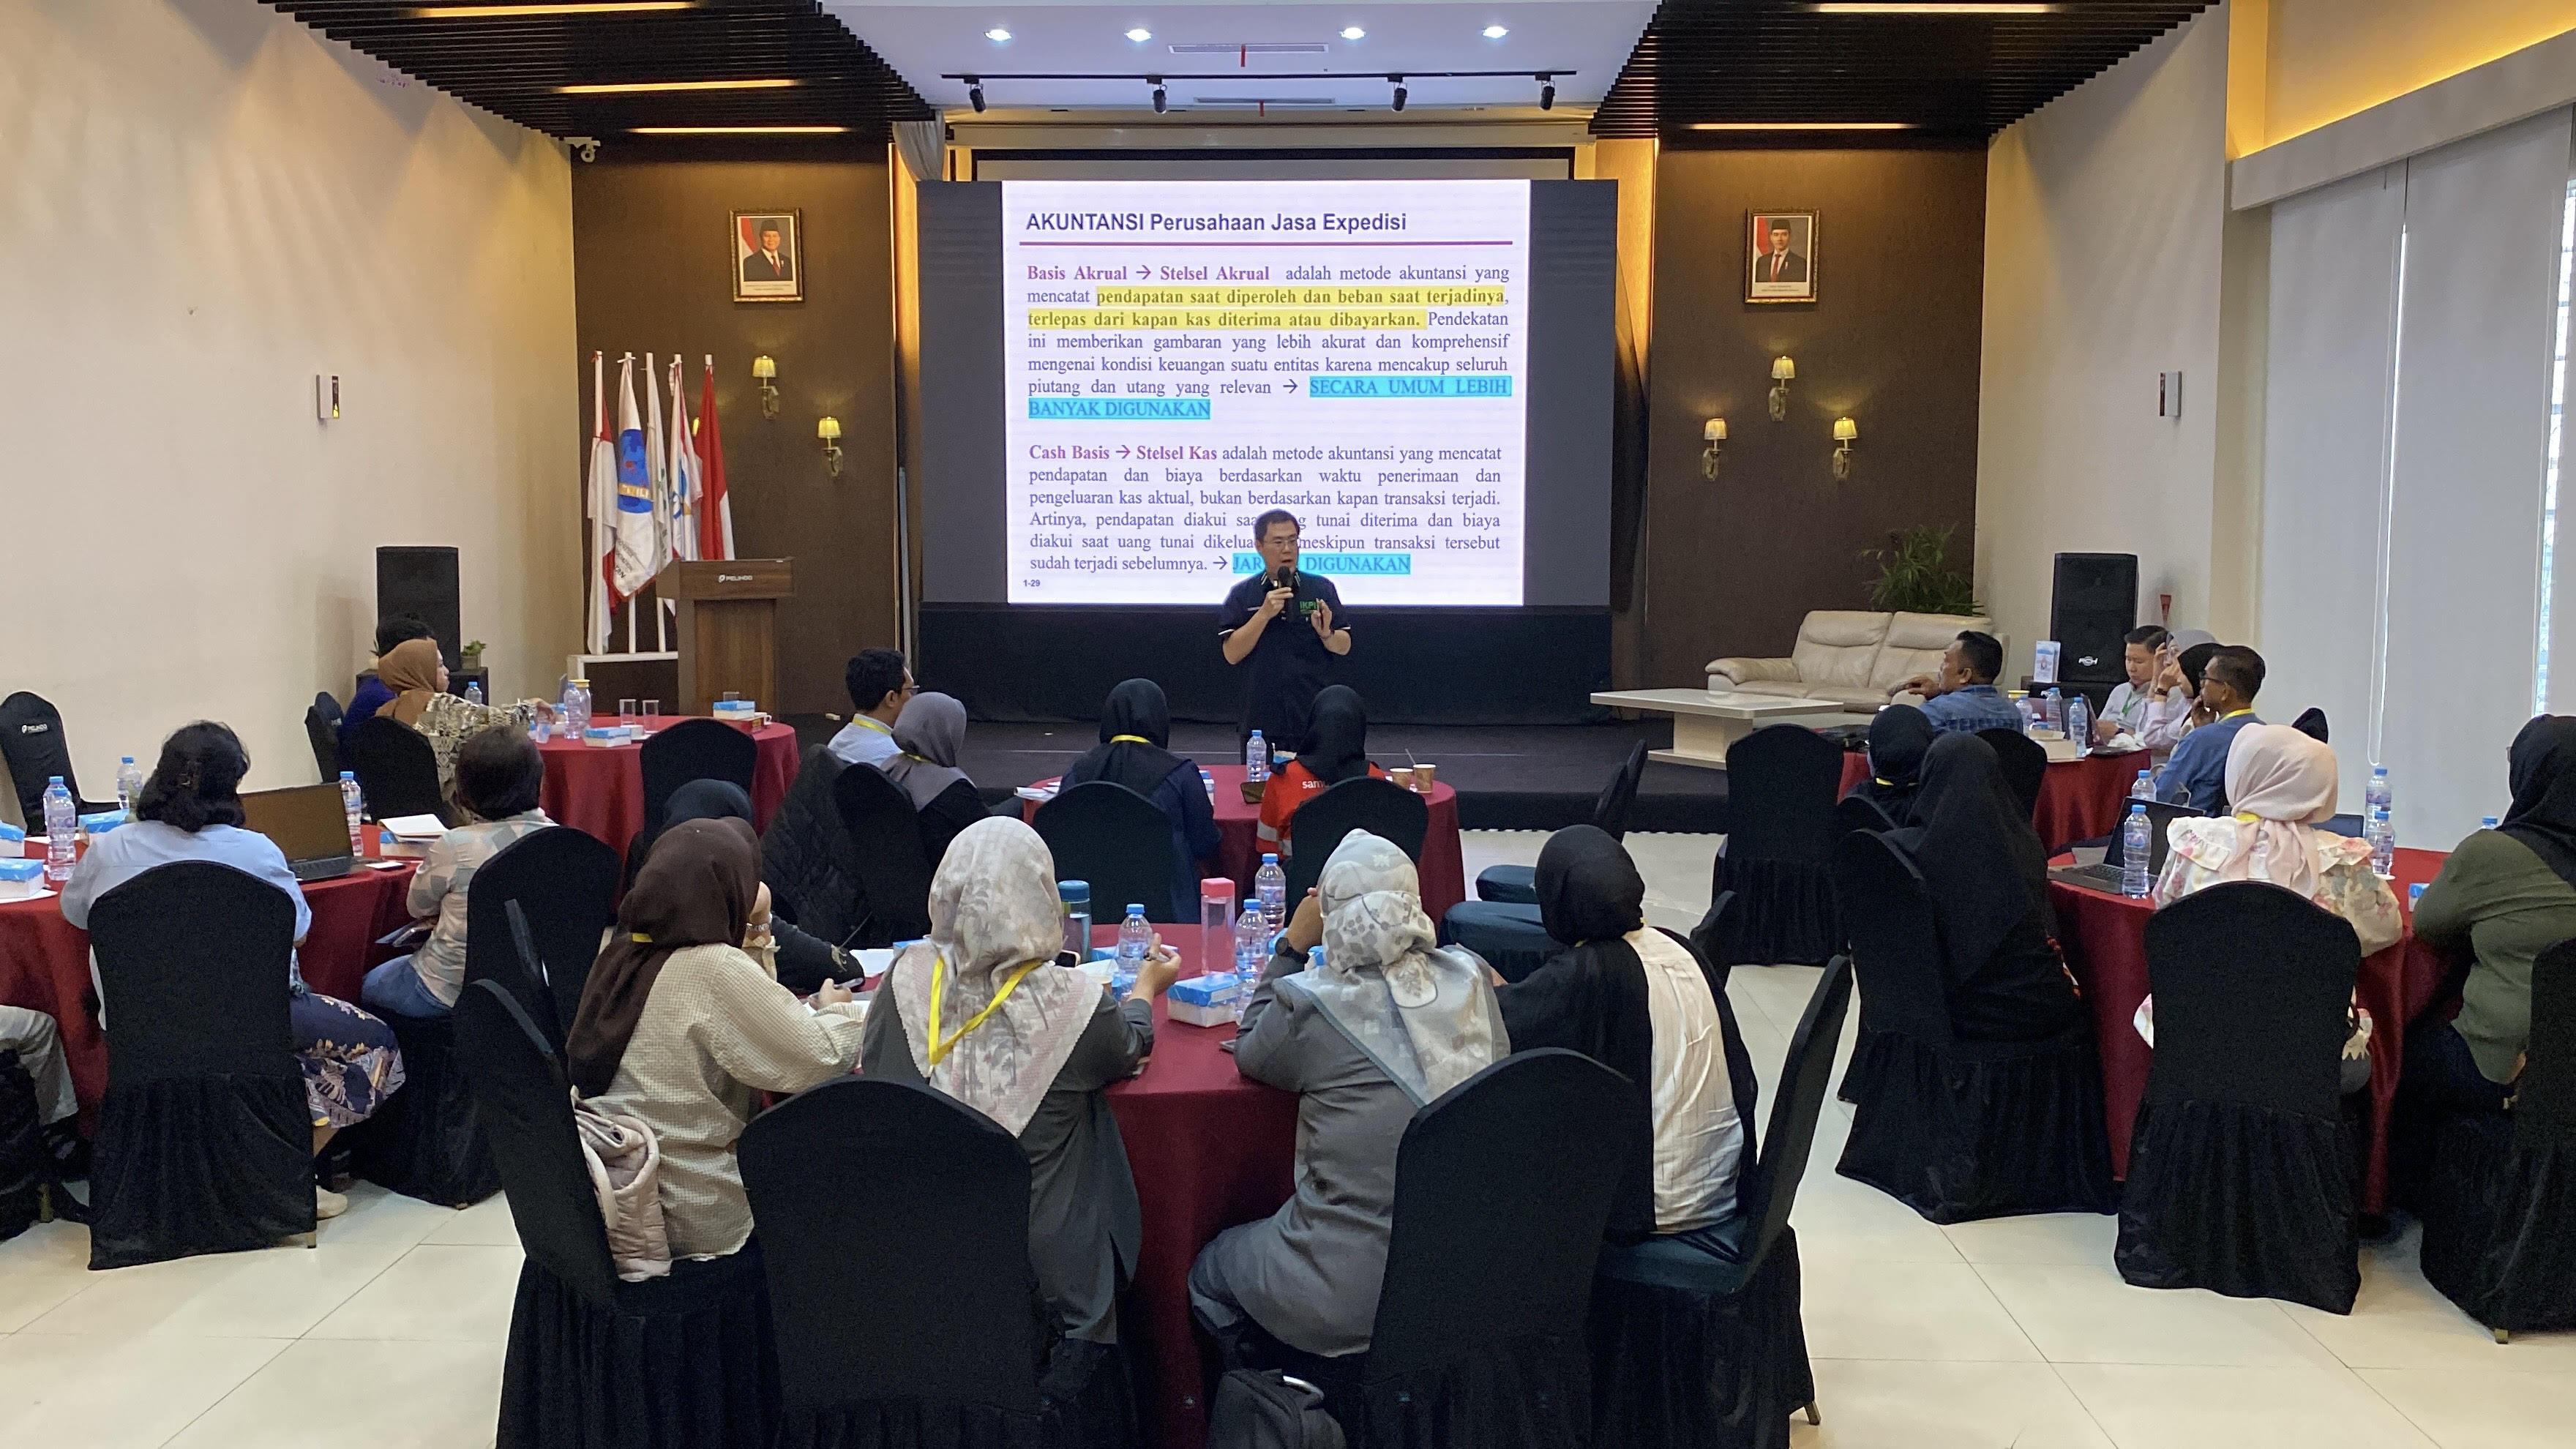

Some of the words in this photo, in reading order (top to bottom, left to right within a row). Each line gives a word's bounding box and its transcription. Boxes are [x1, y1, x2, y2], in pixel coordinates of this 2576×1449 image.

[1026, 213, 1144, 231] AKUNTANSI
[1150, 213, 1265, 231] Perusahaan
[1271, 213, 1317, 231] Jasa
[1323, 213, 1406, 234] Expedisi
[1027, 266, 1066, 280] Basis
[1074, 266, 1127, 280] Akrual
[1161, 266, 1208, 280] Stelsel
[1216, 266, 1270, 280] Akrual
[1286, 266, 1332, 280] adalah
[1339, 265, 1391, 280] metode
[1399, 265, 1467, 280] akuntansi
[1475, 269, 1509, 282] yang
[1027, 290, 1090, 304] mencatat
[1096, 289, 1183, 306] pendapatan
[1190, 291, 1221, 304] saat
[1227, 289, 1296, 306] diperoleh
[1303, 289, 1330, 303] dan
[1338, 289, 1383, 304] beban
[1390, 291, 1420, 304] saat
[1427, 288, 1508, 306] terjadinya,
[1027, 312, 1086, 329] terlepas
[1094, 310, 1124, 326] dari
[1133, 312, 1177, 329] kapan
[1186, 312, 1210, 326] kas
[1218, 310, 1281, 326] diterima
[1289, 313, 1321, 326] atau
[1330, 312, 1420, 329] dibayarkan.
[1428, 311, 1508, 326] Pendekatan
[1028, 333, 1046, 348] ini
[1057, 334, 1143, 348] memberikan
[1153, 334, 1221, 352] gambaran
[1232, 339, 1266, 352] yang
[1277, 334, 1311, 348] lebih
[1322, 334, 1366, 348] akurat
[1376, 334, 1401, 348] dan
[1412, 334, 1510, 352] komprehensif
[1028, 356, 1095, 374] mengenai
[1101, 356, 1153, 371] kondisi
[1158, 357, 1225, 374] keuangan
[1231, 359, 1268, 371] suatu
[1274, 357, 1319, 371] entitas
[1325, 357, 1373, 371] karena
[1378, 356, 1450, 374] mencakup
[1456, 356, 1508, 371] seluruh
[1028, 378, 1080, 397] piutang
[1091, 379, 1116, 393] dan
[1126, 381, 1165, 397] utang
[1175, 382, 1210, 397] yang
[1220, 379, 1271, 394] relevan
[1311, 380, 1377, 393] SECARA
[1388, 380, 1444, 393] UMUM
[1456, 380, 1506, 393] LEBIH
[1030, 402, 1101, 415] BANYAK
[1105, 402, 1210, 416] DIGUNAKAN
[1030, 445, 1066, 459] Cash
[1071, 446, 1109, 460] Basis
[1137, 446, 1183, 460] Stelsel
[1188, 446, 1217, 460] Kas
[1222, 446, 1268, 460] adalah
[1273, 446, 1323, 460] metode
[1328, 446, 1394, 460] akuntansi
[1399, 450, 1434, 464] yang
[1439, 447, 1502, 460] mencatat
[1029, 468, 1107, 485] pendapatan
[1124, 468, 1149, 482] dan
[1165, 468, 1203, 485] biaya
[1219, 468, 1302, 482] berdasarkan
[1318, 468, 1361, 482] waktu
[1377, 468, 1459, 486] penerimaan
[1476, 468, 1500, 482] dan
[1030, 490, 1114, 507] pengeluaran
[1119, 490, 1142, 503] kas
[1148, 490, 1194, 506] aktual,
[1200, 490, 1242, 504] bukan
[1248, 490, 1331, 504] berdasarkan
[1337, 490, 1378, 508] kapan
[1385, 490, 1445, 505] transaksi
[1452, 490, 1499, 509] terjadi.
[1030, 512, 1086, 529] Artinya,
[1096, 512, 1174, 529] pendapatan
[1184, 512, 1227, 526] diakui
[1236, 517, 1256, 527] saa
[1317, 512, 1350, 527] tunai
[1360, 512, 1418, 527] diterima
[1428, 512, 1453, 527] dan
[1463, 512, 1500, 531] biaya
[1030, 533, 1072, 547] diakui
[1082, 536, 1109, 547] saat
[1117, 539, 1151, 552] uang
[1160, 534, 1194, 548] tunai
[1204, 534, 1252, 548] dikelua
[1299, 535, 1365, 553] meskipun
[1374, 535, 1435, 549] transaksi
[1445, 535, 1500, 549] tersebut
[1030, 555, 1071, 569] sudah
[1075, 555, 1117, 573] terjadi
[1123, 555, 1207, 574] sebelumnya.
[1233, 558, 1262, 571] JAR
[1306, 558, 1409, 572] DIGUNAKAN
